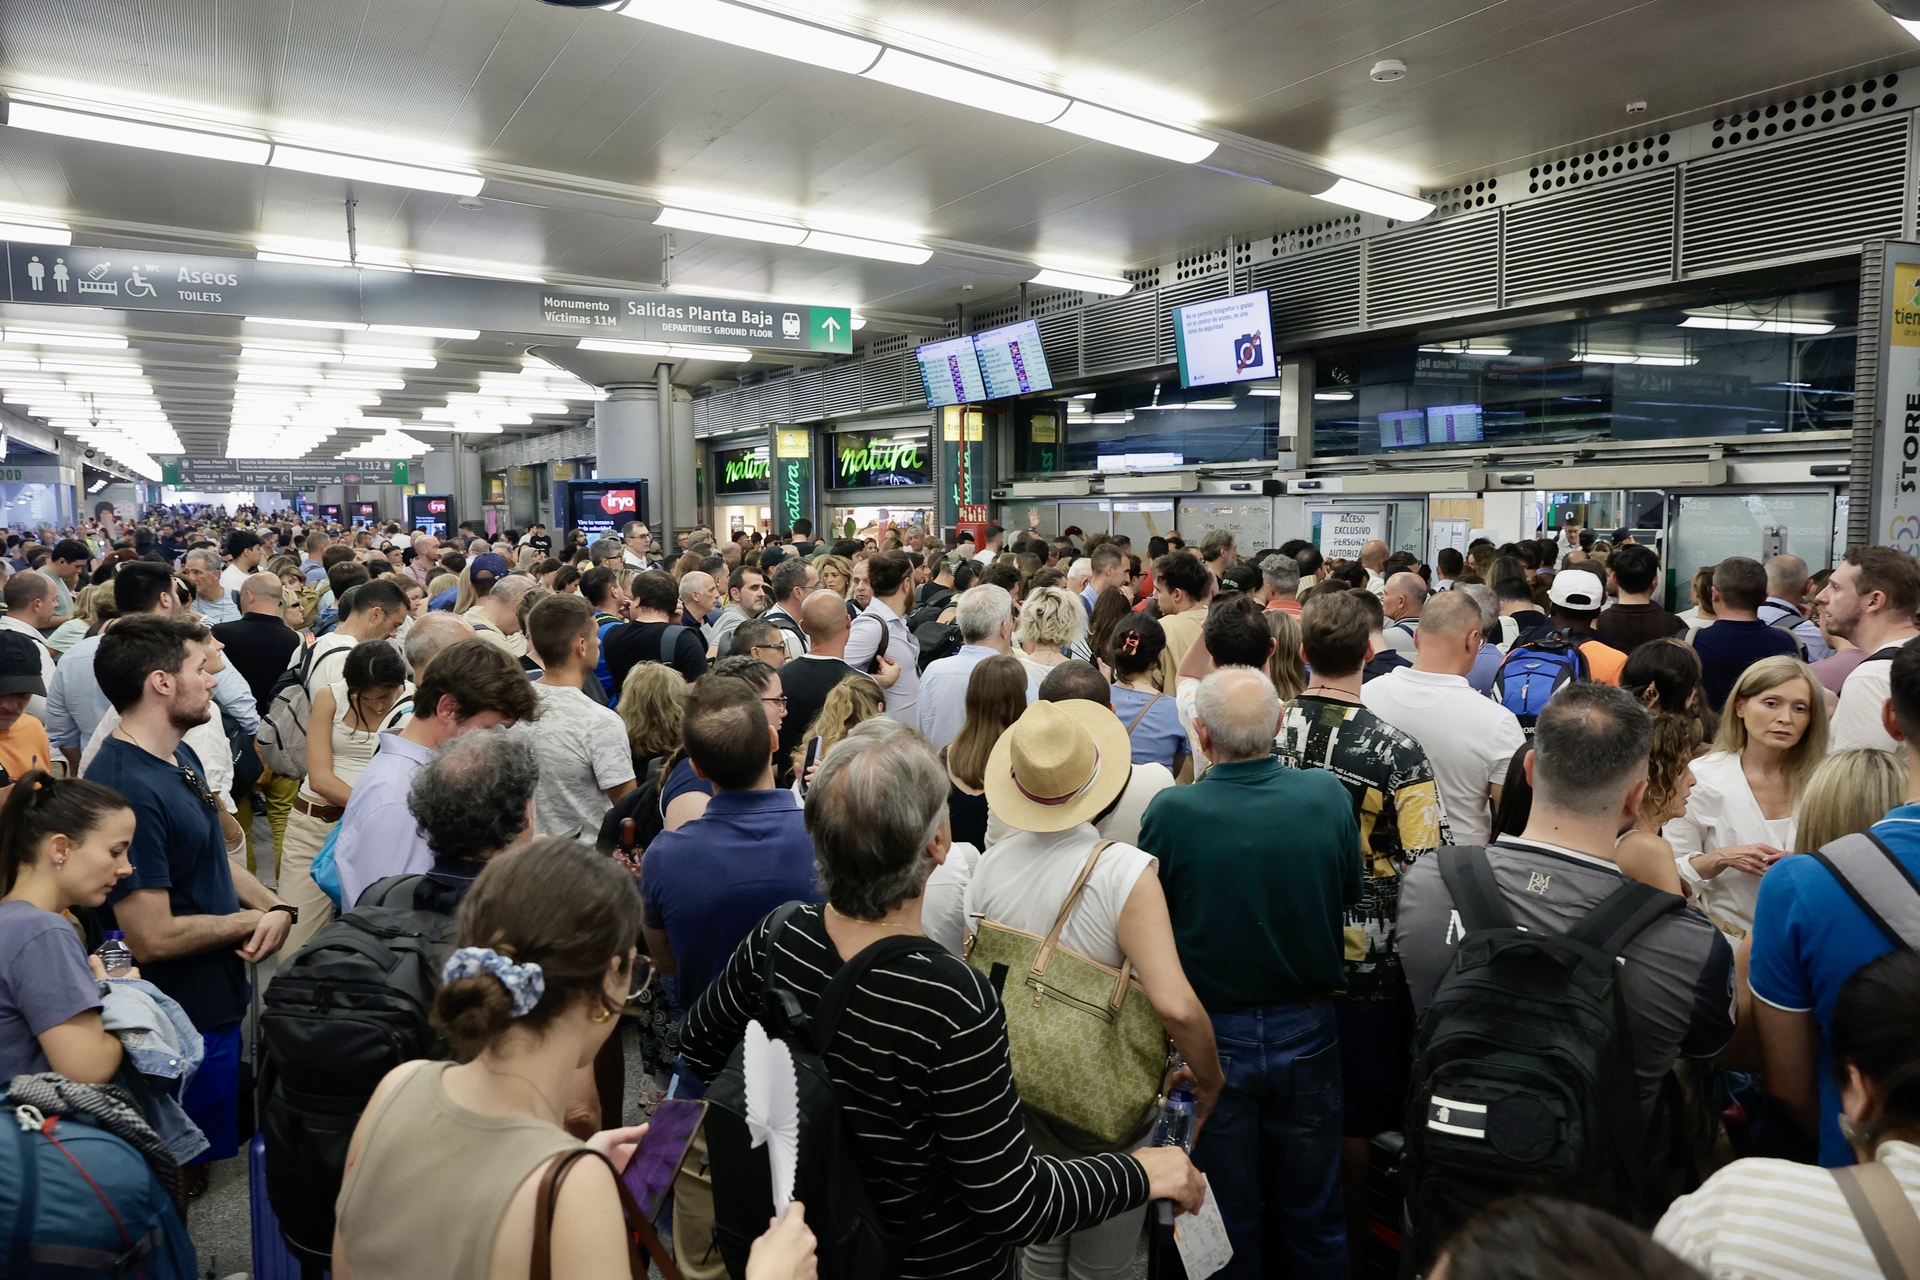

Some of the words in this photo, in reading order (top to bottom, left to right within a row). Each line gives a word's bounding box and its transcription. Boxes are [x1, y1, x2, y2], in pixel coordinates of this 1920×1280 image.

[145, 264, 160, 272] WC
[177, 266, 238, 286] Aseos
[177, 290, 222, 303] TOILETS
[544, 296, 610, 311] Monumento
[628, 301, 684, 319] Salidas
[689, 306, 737, 323] Planta
[742, 310, 773, 328] Baja
[1198, 310, 1213, 318] permite
[1214, 305, 1236, 315] fotografiar
[1240, 302, 1254, 311] grabar
[545, 311, 591, 325] Víctimas
[594, 315, 617, 326] 11M
[1198, 317, 1211, 325] control
[662, 322, 712, 335] DEPARTURES
[714, 326, 747, 337] GROUND
[750, 328, 773, 339] FLOOR
[1203, 323, 1224, 332] seguridad
[947, 423, 979, 432] tiedas
[779, 443, 806, 451] tiendas
[1901, 394, 1920, 492] STORE
[841, 437, 923, 477] natura
[369, 461, 380, 470] 12
[725, 452, 771, 484] natur
[430, 500, 446, 512] iryo
[607, 494, 634, 511] iryo
[1340, 515, 1365, 523] ACCESO
[1334, 526, 1371, 535] EXCLUSIVO
[1702, 525, 1750, 535] tiendas
[1343, 770, 1379, 787] LANGUAGE
